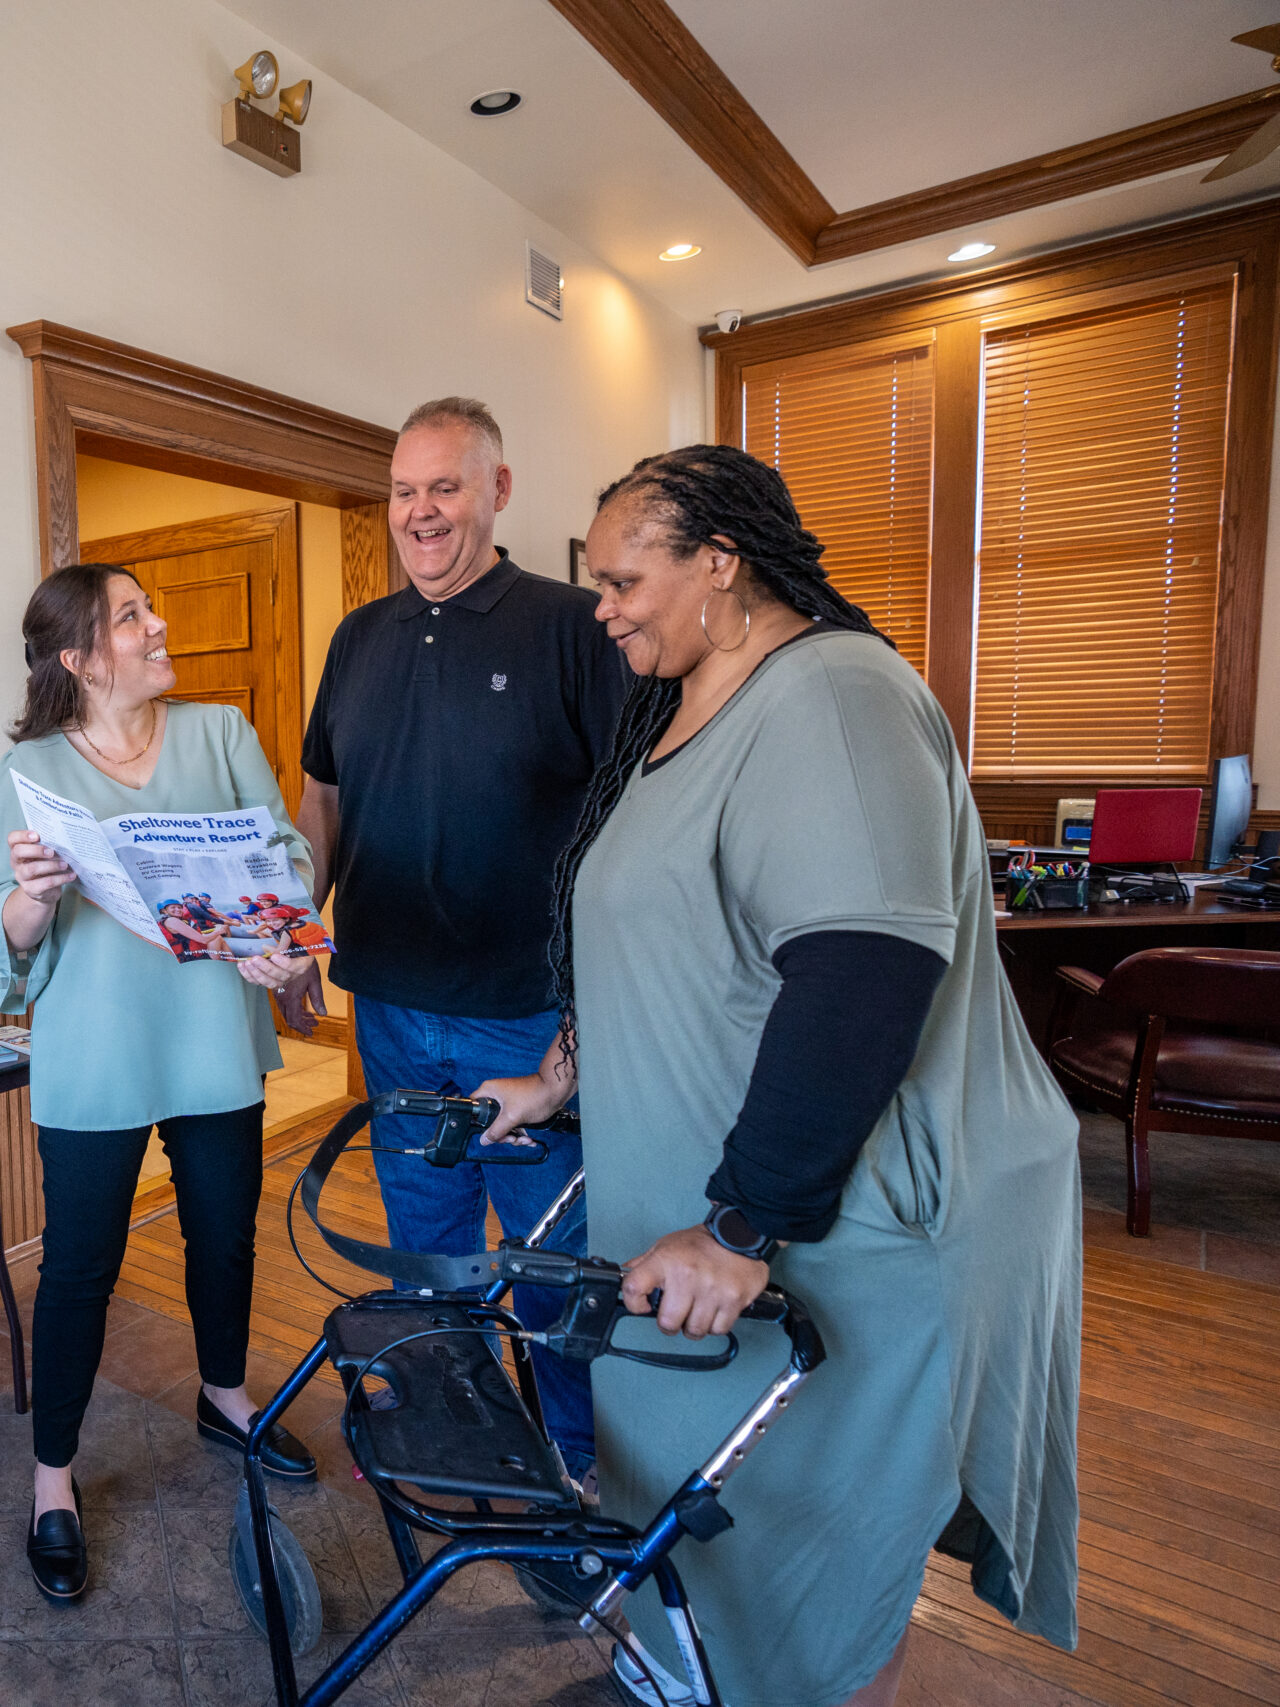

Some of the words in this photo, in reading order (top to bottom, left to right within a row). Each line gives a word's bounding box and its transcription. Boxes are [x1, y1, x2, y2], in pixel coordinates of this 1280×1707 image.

[18, 779, 40, 796] Sheltowee
[52, 796, 78, 813] Adventure
[39, 797, 68, 817] Cumberland
[118, 816, 202, 832] Sheltowee
[202, 817, 257, 830] Trace
[133, 832, 206, 844] Adventure
[208, 831, 262, 844] Resort
[150, 868, 174, 877] Camping
[157, 872, 181, 881] Camping
[251, 871, 284, 881] Riverboat
